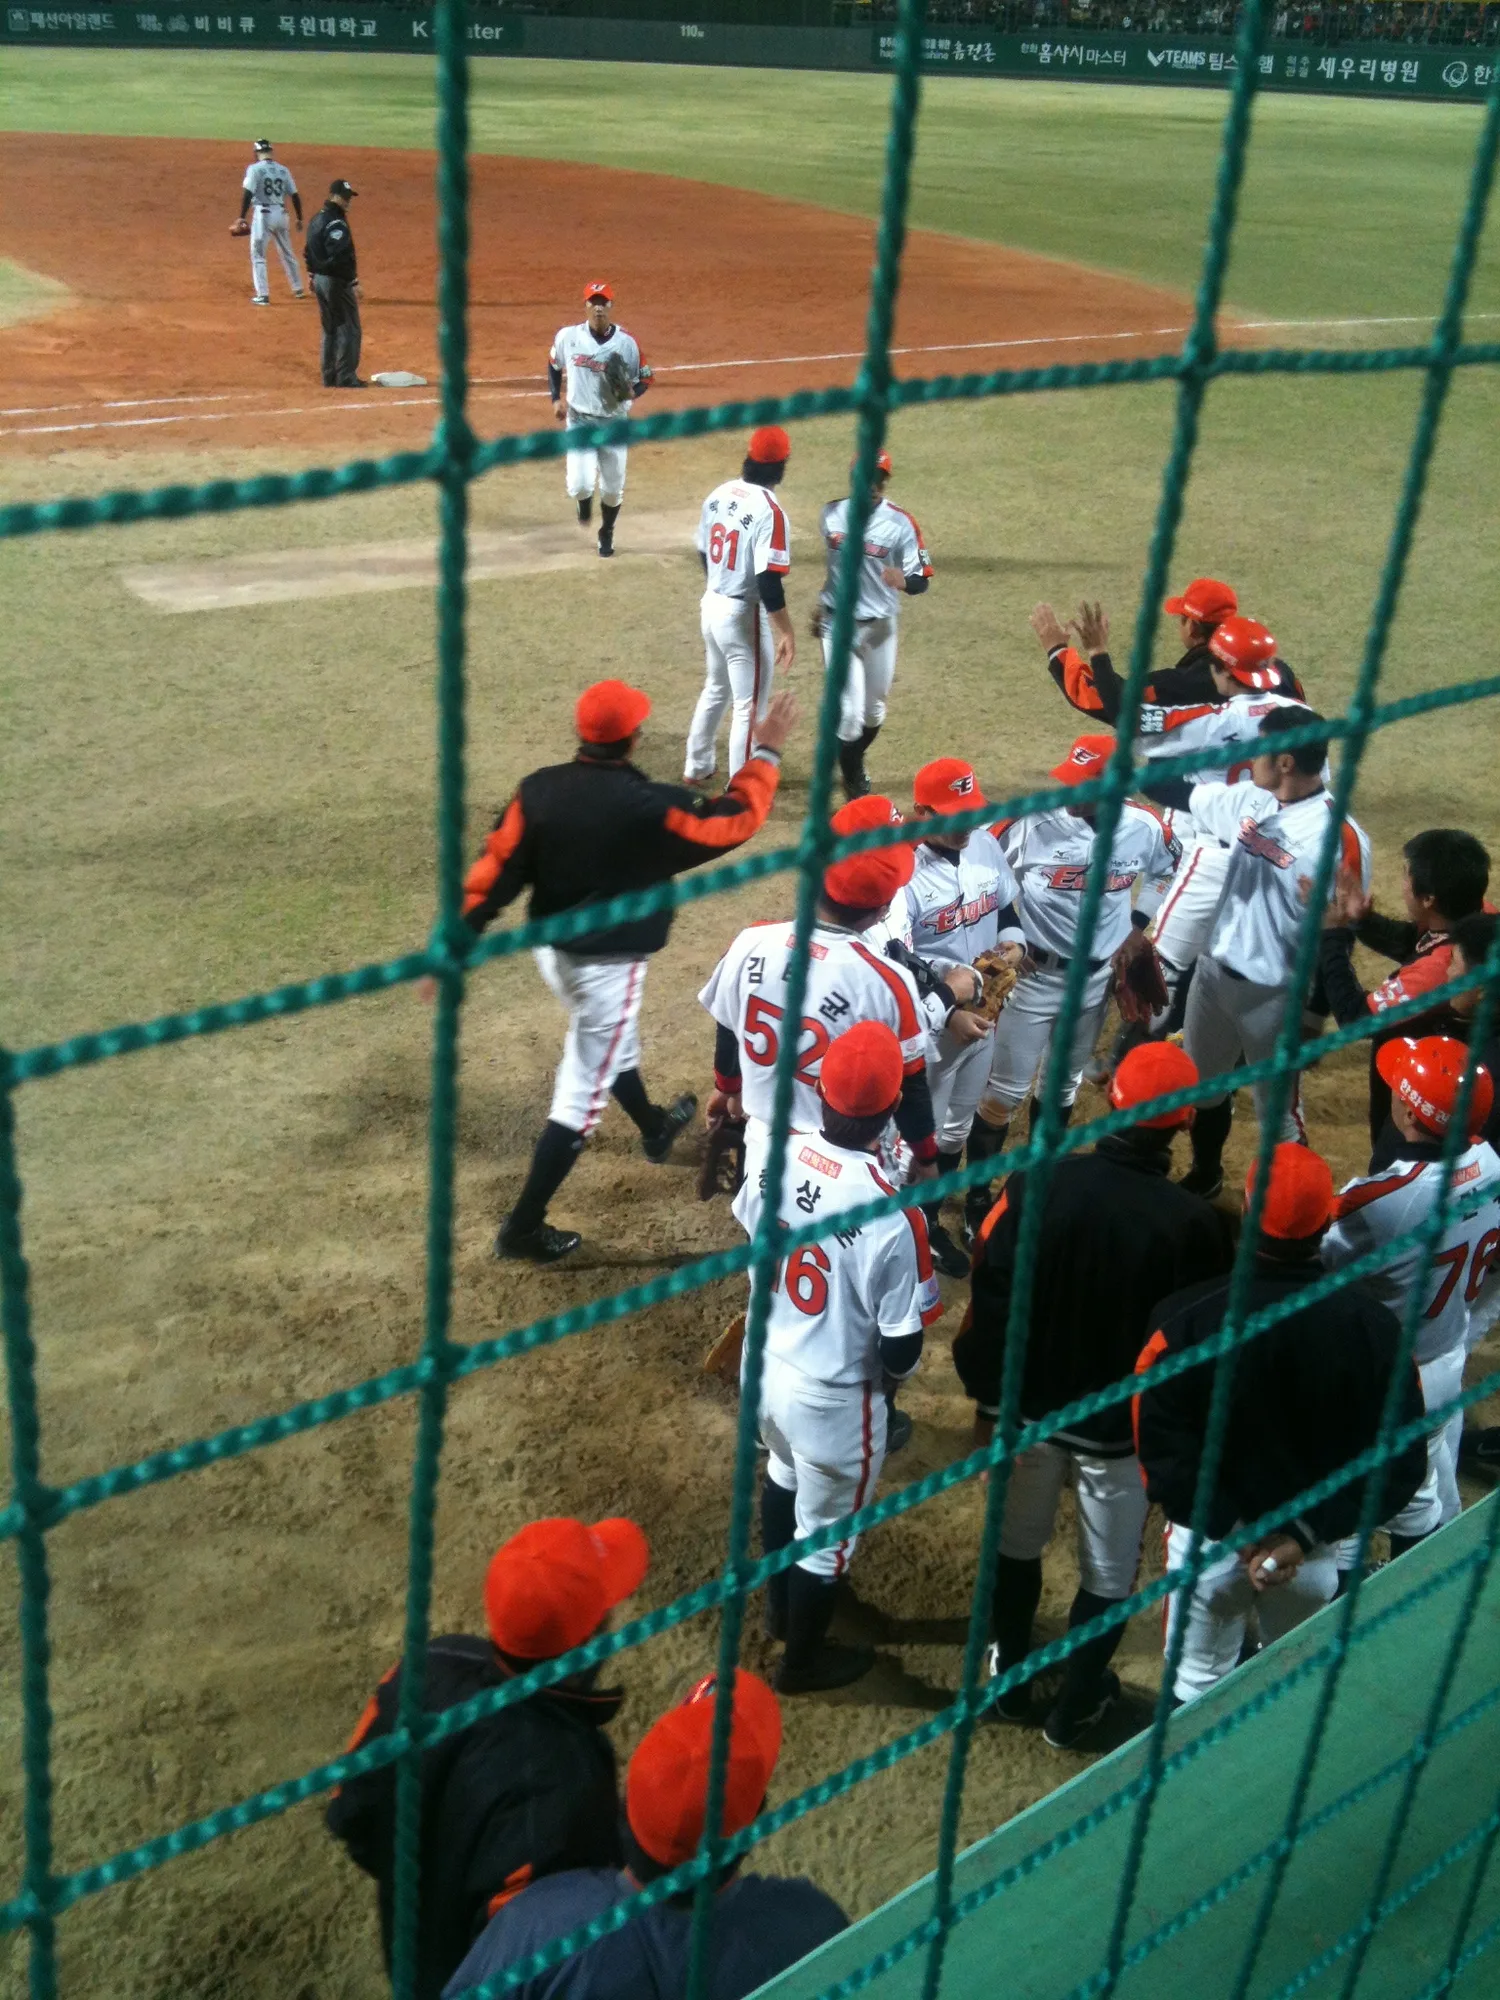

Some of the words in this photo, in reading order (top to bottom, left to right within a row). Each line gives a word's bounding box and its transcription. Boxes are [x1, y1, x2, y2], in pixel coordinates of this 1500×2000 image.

[278, 15, 378, 37] 목원대학교
[1165, 50, 1206, 65] TEAMS
[1317, 57, 1419, 83] 세우리병원
[263, 177, 283, 197] 83
[709, 522, 740, 571] 61
[744, 993, 831, 1088] 52
